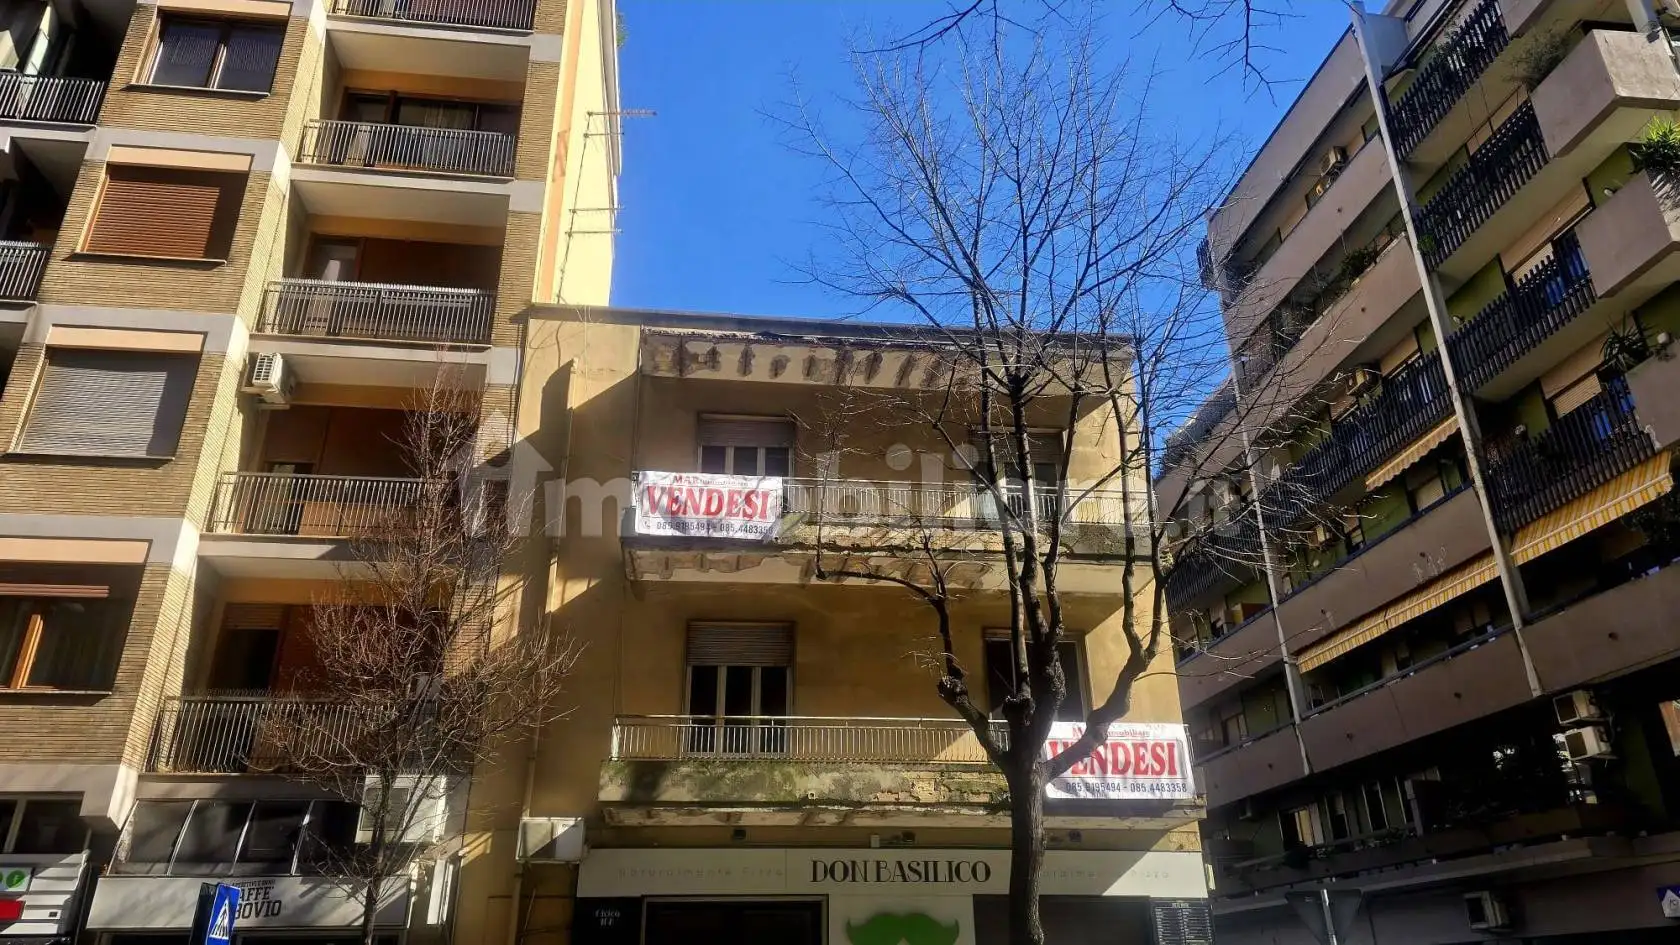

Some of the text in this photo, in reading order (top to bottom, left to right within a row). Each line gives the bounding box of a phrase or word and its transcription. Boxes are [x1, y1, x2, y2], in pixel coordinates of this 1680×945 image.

[646, 485, 770, 521] VENDESI
[1130, 782, 1187, 793] 085.4483358
[810, 860, 991, 882] DON BASILICO
